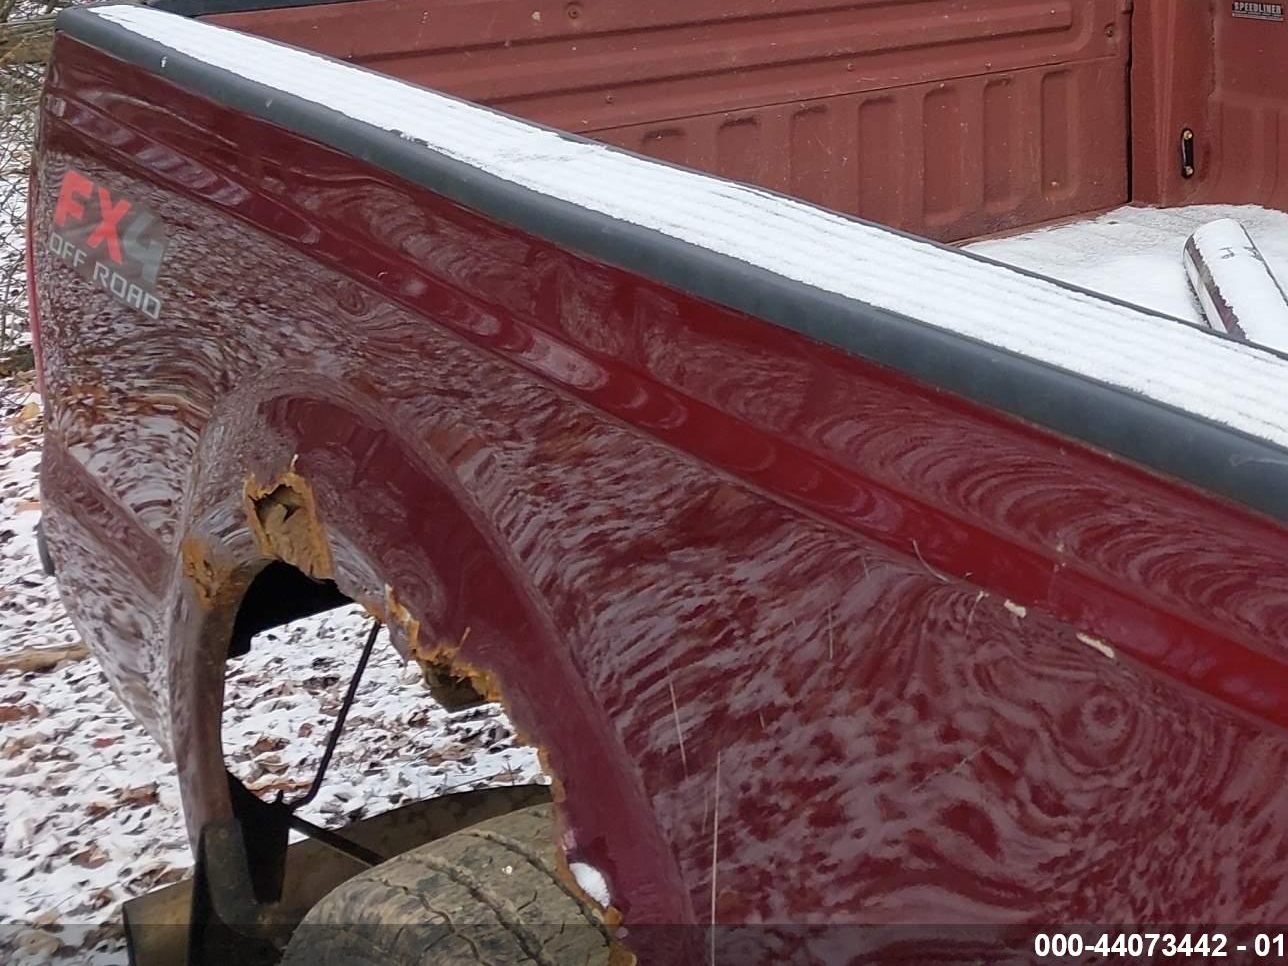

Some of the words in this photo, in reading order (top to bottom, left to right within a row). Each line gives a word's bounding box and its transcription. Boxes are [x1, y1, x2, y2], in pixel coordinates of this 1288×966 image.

[1234, 1, 1282, 15] SPEEDLINER
[54, 169, 165, 283] FX4
[49, 231, 88, 268] OFF
[92, 260, 162, 320] ROAD
